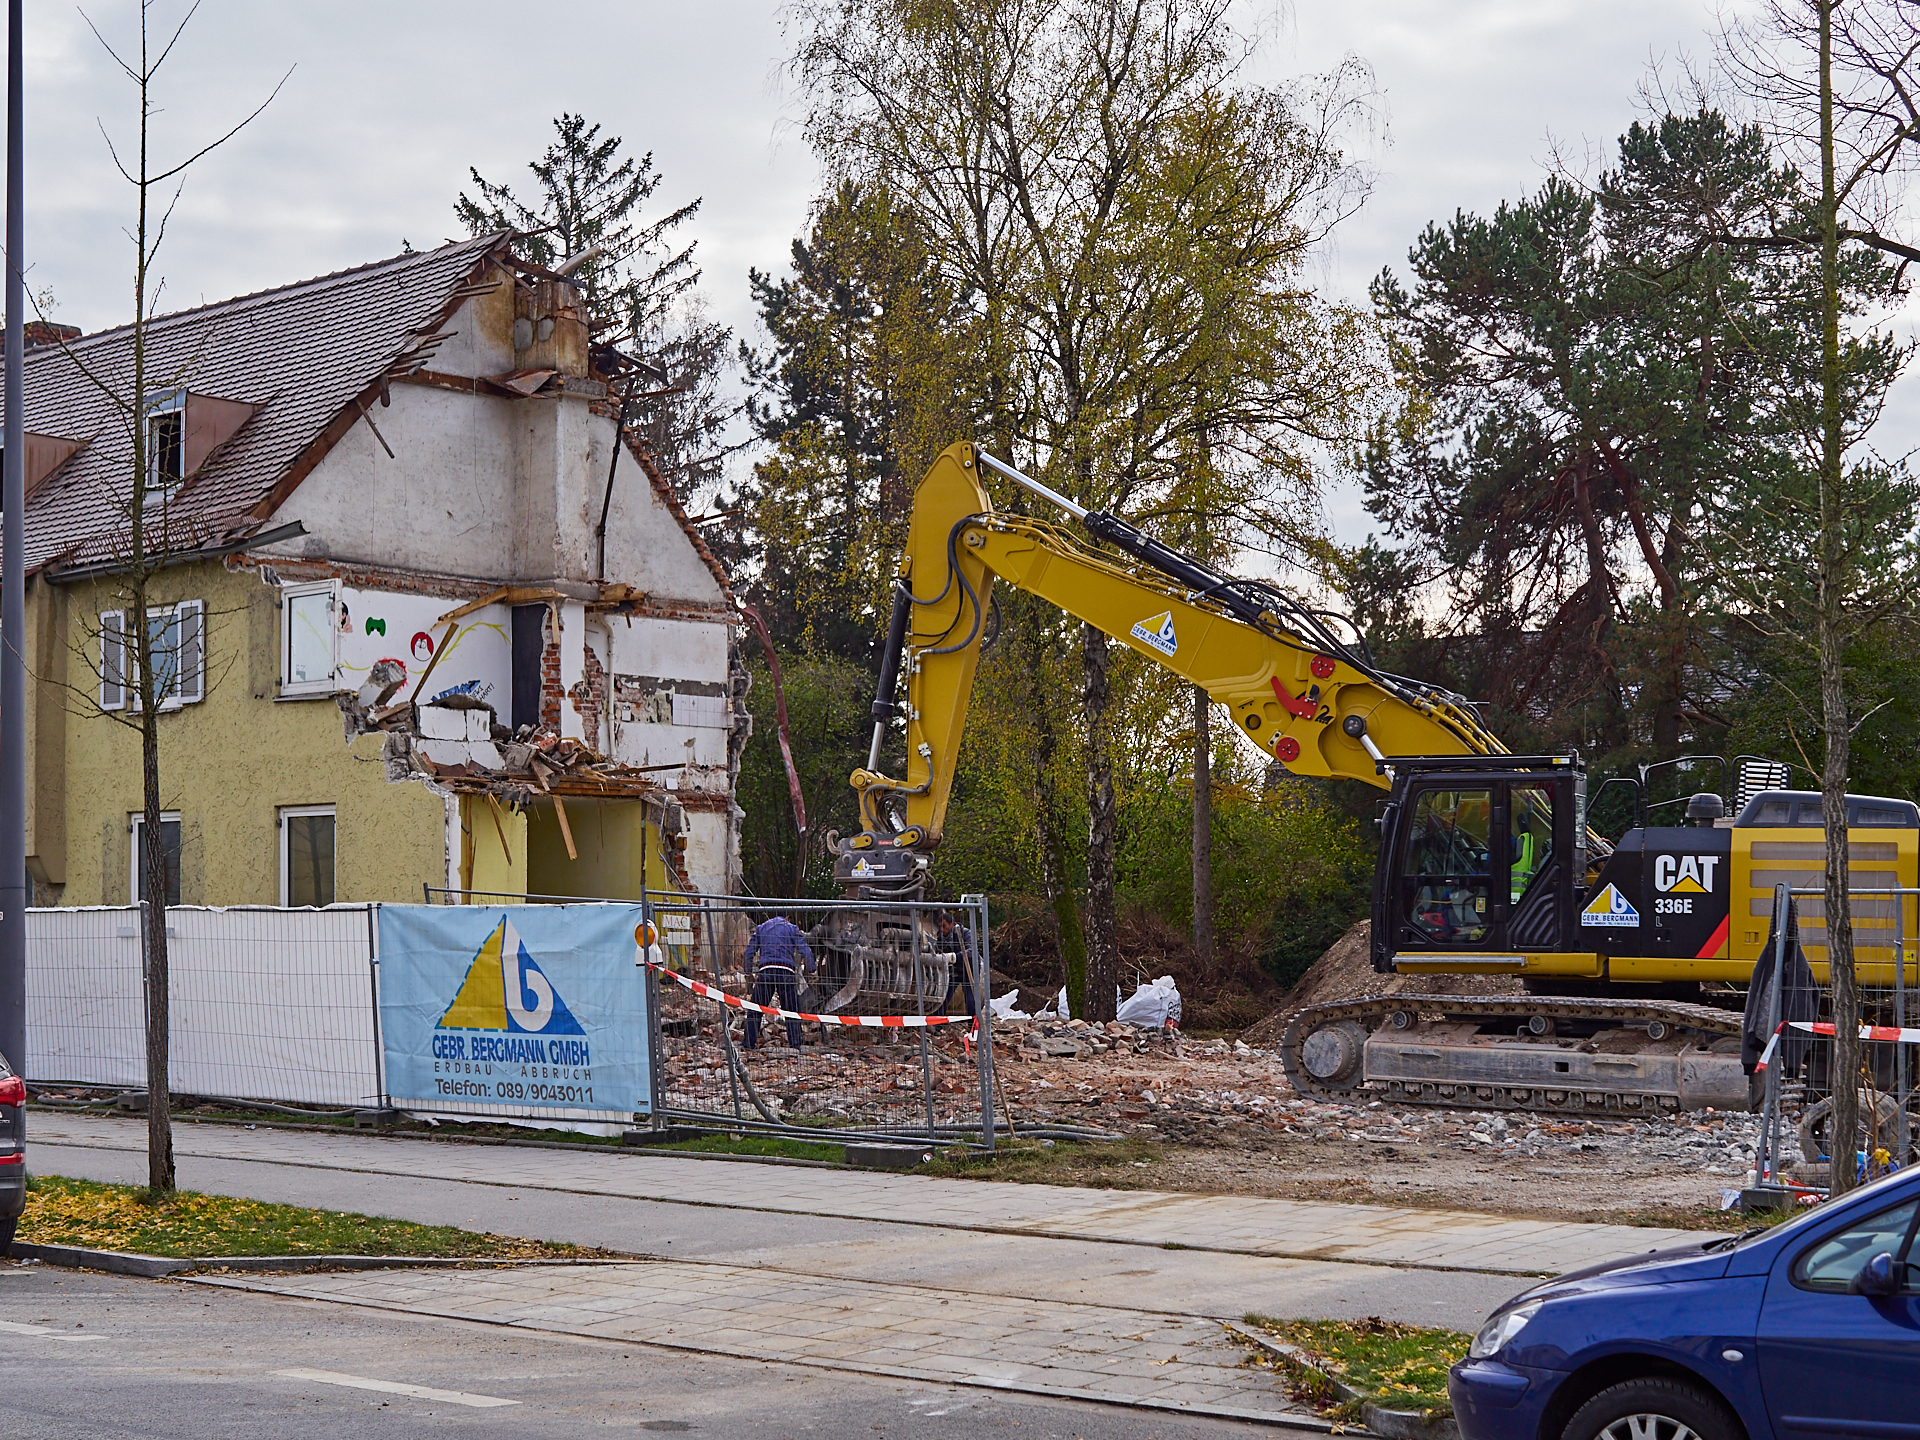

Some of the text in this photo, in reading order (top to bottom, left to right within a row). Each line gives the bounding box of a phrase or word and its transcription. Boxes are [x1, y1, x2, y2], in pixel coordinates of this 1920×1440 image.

[1133, 626, 1147, 637] GEBR.
[1147, 633, 1176, 652] BERGMANN
[1654, 854, 1719, 893] CAT
[1654, 898, 1693, 914] 336E
[1582, 914, 1638, 922] GEBR. BERGMANN
[1655, 915, 1663, 927] L
[432, 1034, 591, 1066] GEBR. BERGMANN GMBH
[434, 1061, 592, 1081] ERDBAU ABBRUCH
[434, 1078, 594, 1103] Telefon: 089/9043011
